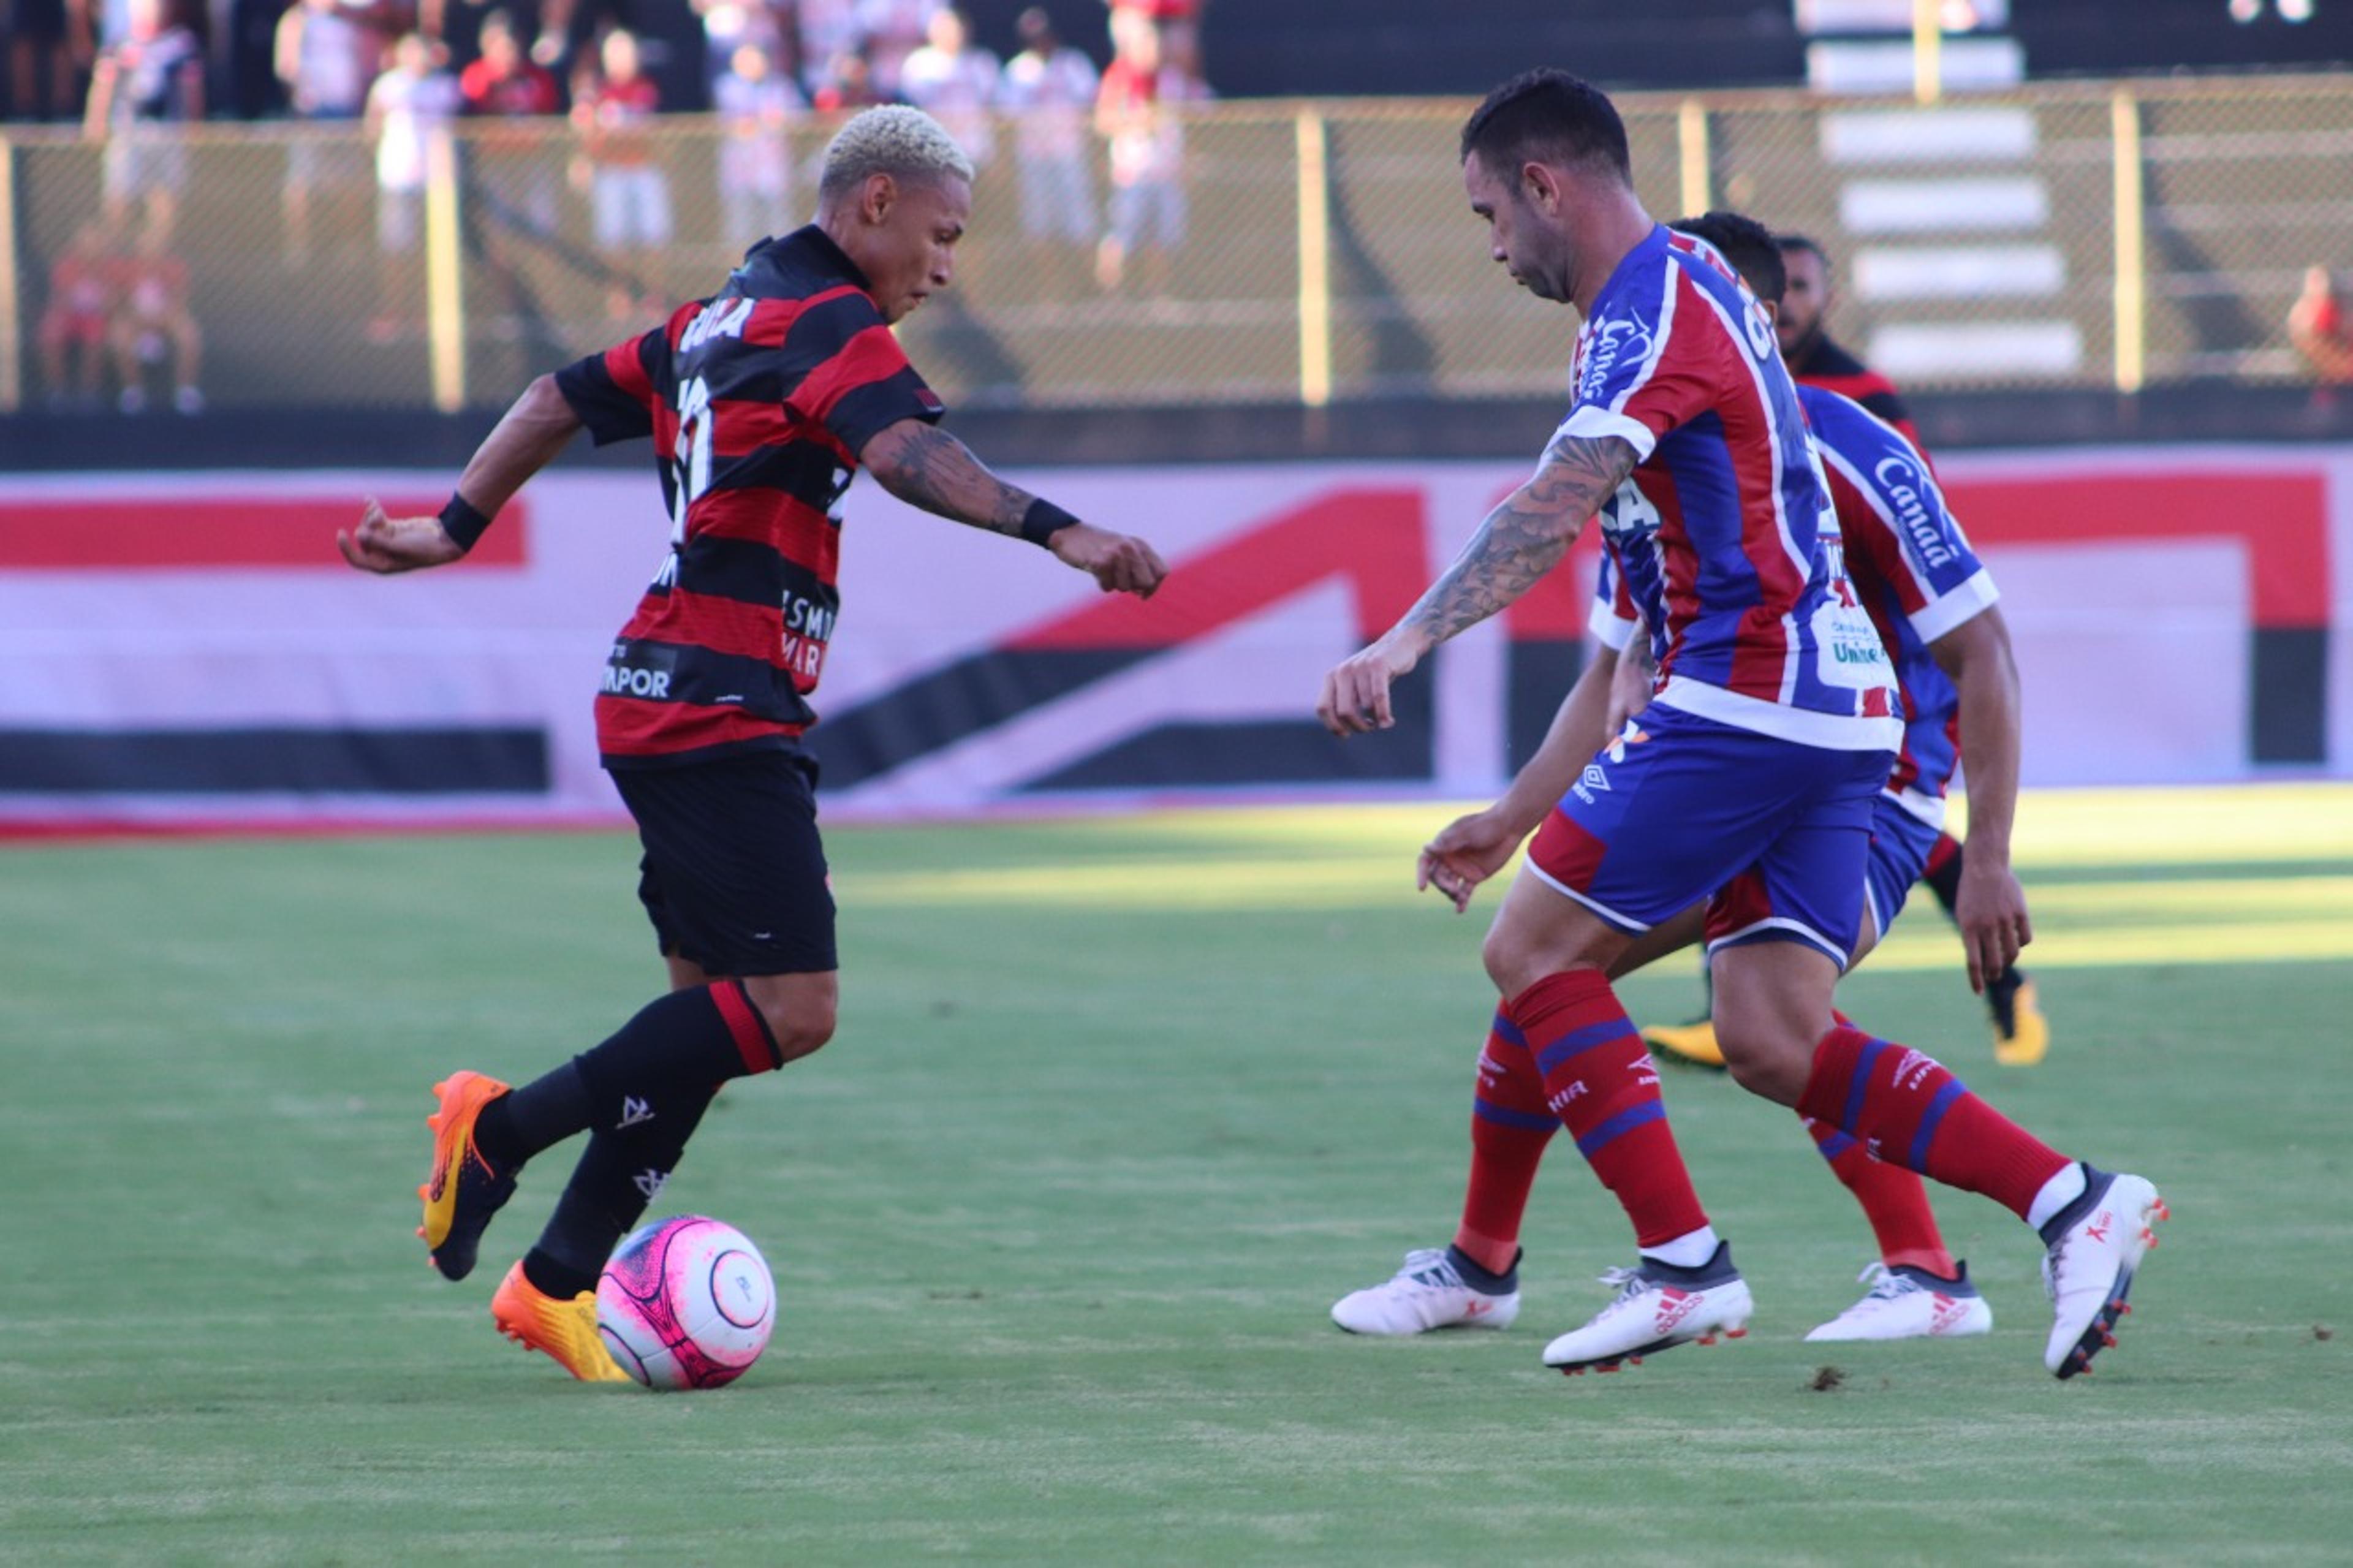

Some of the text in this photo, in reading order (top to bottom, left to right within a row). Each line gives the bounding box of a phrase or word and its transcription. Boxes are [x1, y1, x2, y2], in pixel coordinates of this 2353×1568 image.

[1599, 476, 1661, 532] A
[1875, 457, 1960, 568] Canaã
[601, 665, 670, 699] APOR
[1655, 1293, 1705, 1335] adidas
